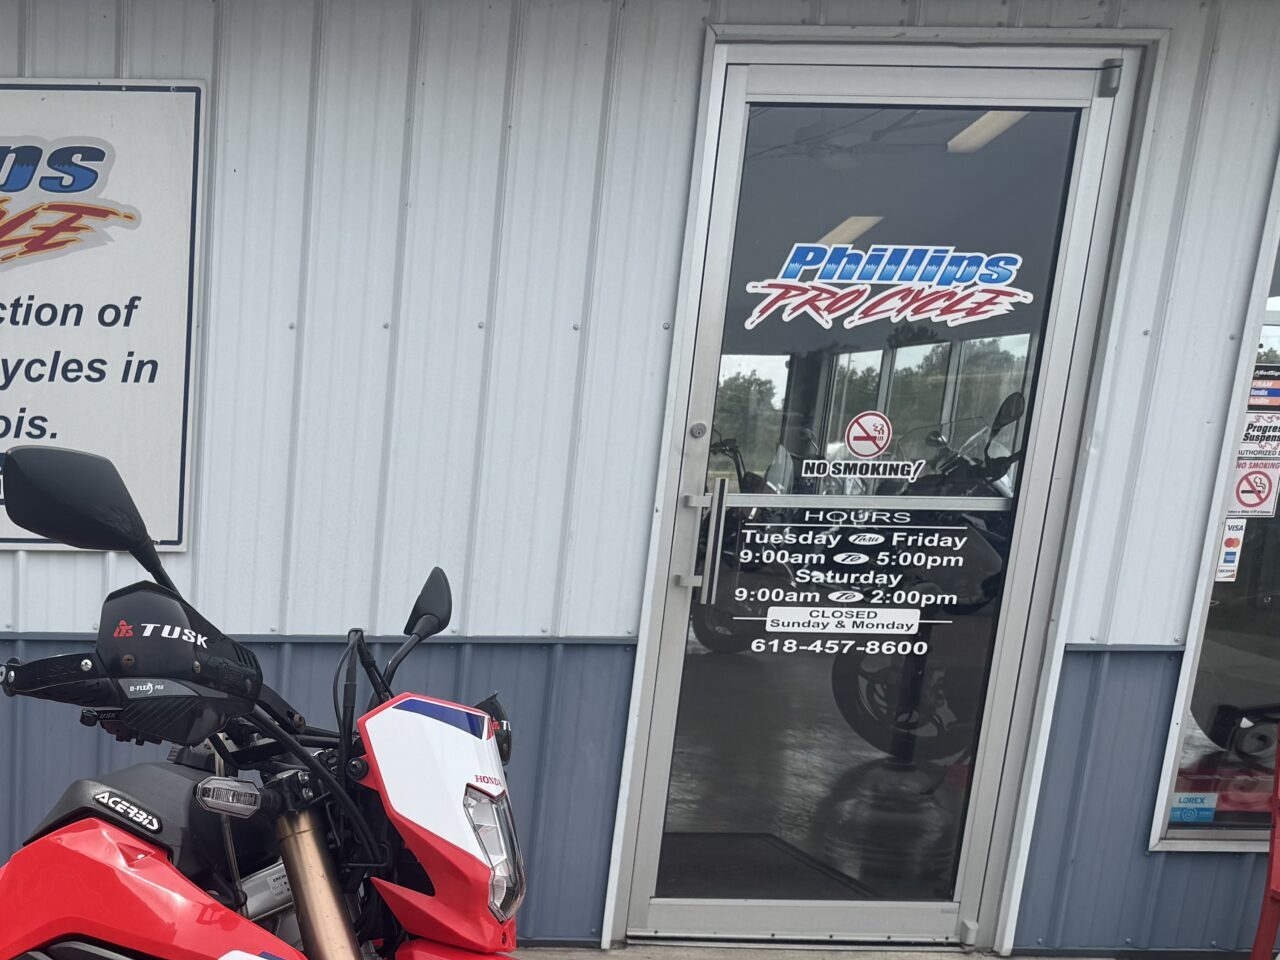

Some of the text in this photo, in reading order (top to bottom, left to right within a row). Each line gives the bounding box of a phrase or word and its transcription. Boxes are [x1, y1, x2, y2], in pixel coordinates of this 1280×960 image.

[780, 244, 1021, 287] Phillips
[97, 296, 141, 328] of
[748, 281, 1032, 328] PRO CYCLE
[121, 351, 159, 383] in
[803, 460, 926, 483] NO SMOKING!
[804, 510, 911, 523] HOURS
[741, 529, 842, 548] Tuesday
[892, 532, 968, 550] Friday
[739, 550, 825, 564] 9:00am
[876, 552, 964, 569] 5:00pm
[795, 569, 903, 587] Saturday
[734, 588, 820, 602] 9:00am
[870, 590, 958, 607] 2:00pm
[809, 610, 878, 619] CLOSED
[770, 619, 914, 632] Sunday & Monday
[141, 623, 208, 649] TUSK
[750, 638, 929, 655] 618-457-8600
[475, 774, 503, 787] HONDA
[1178, 796, 1206, 804] LOREX
